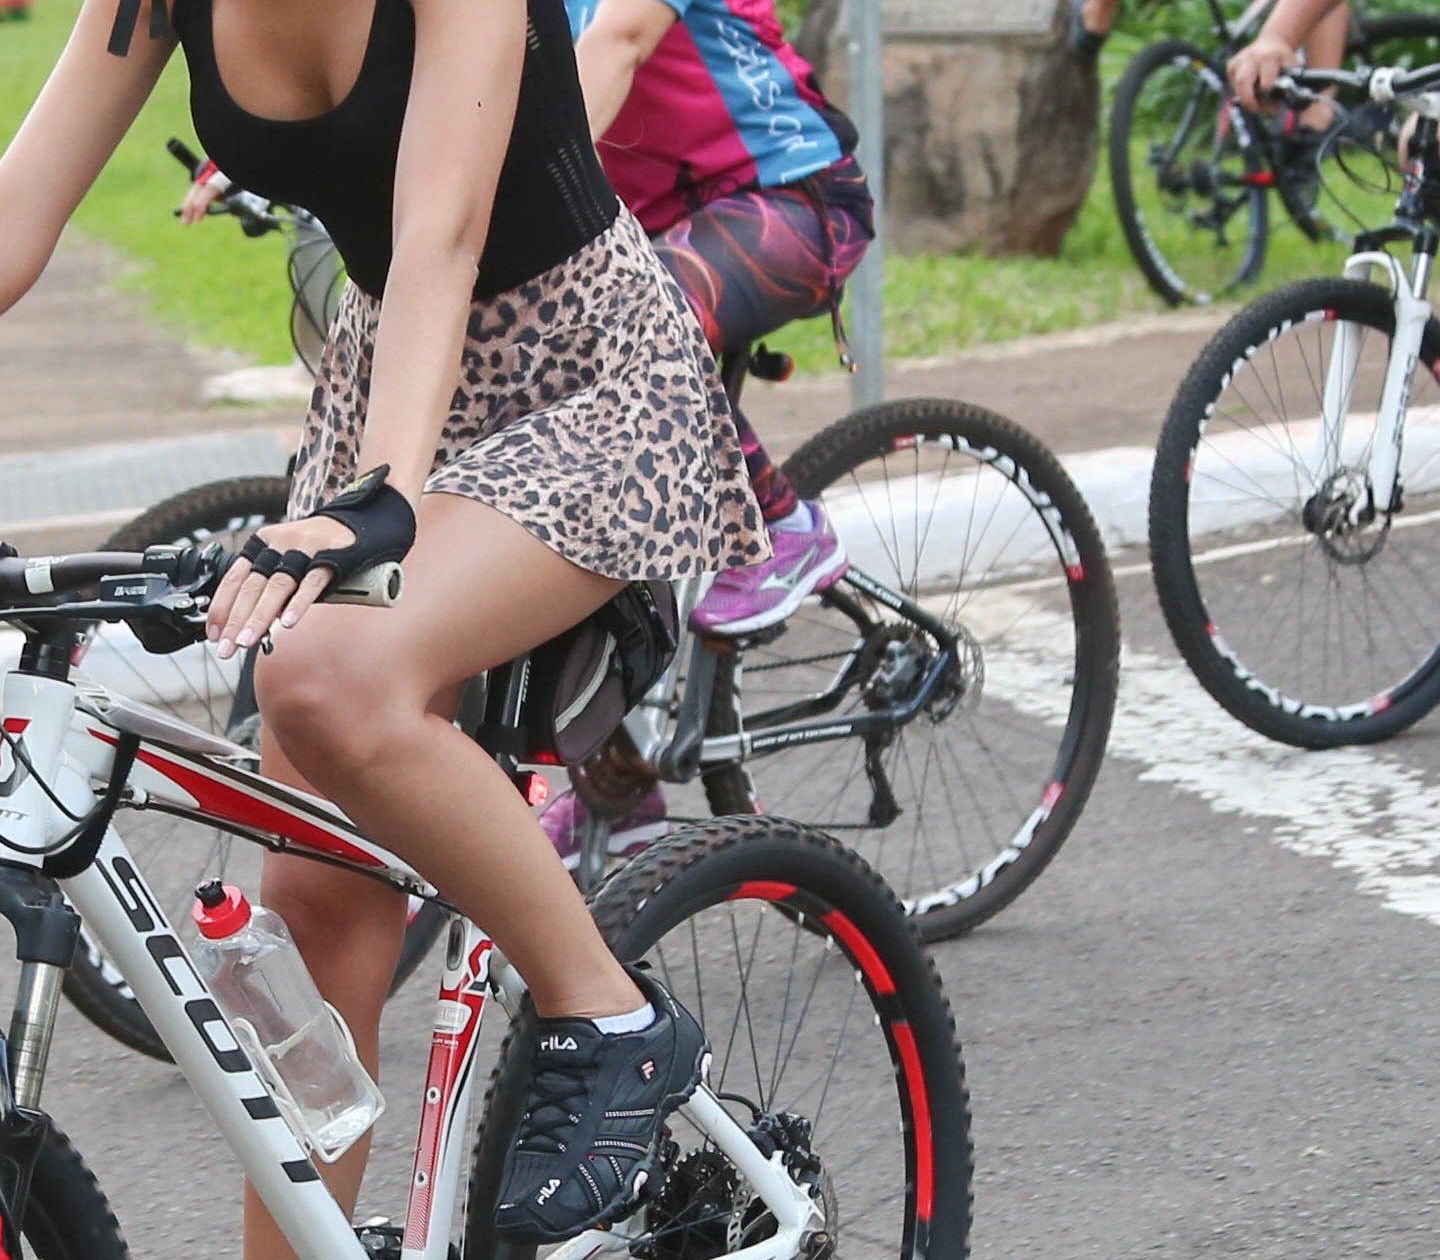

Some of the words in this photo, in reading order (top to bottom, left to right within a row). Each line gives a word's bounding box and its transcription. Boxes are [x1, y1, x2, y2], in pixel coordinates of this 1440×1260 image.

[94, 855, 323, 1184] SCOTT
[540, 1034, 579, 1052] FILA
[536, 1177, 562, 1207] FILA
